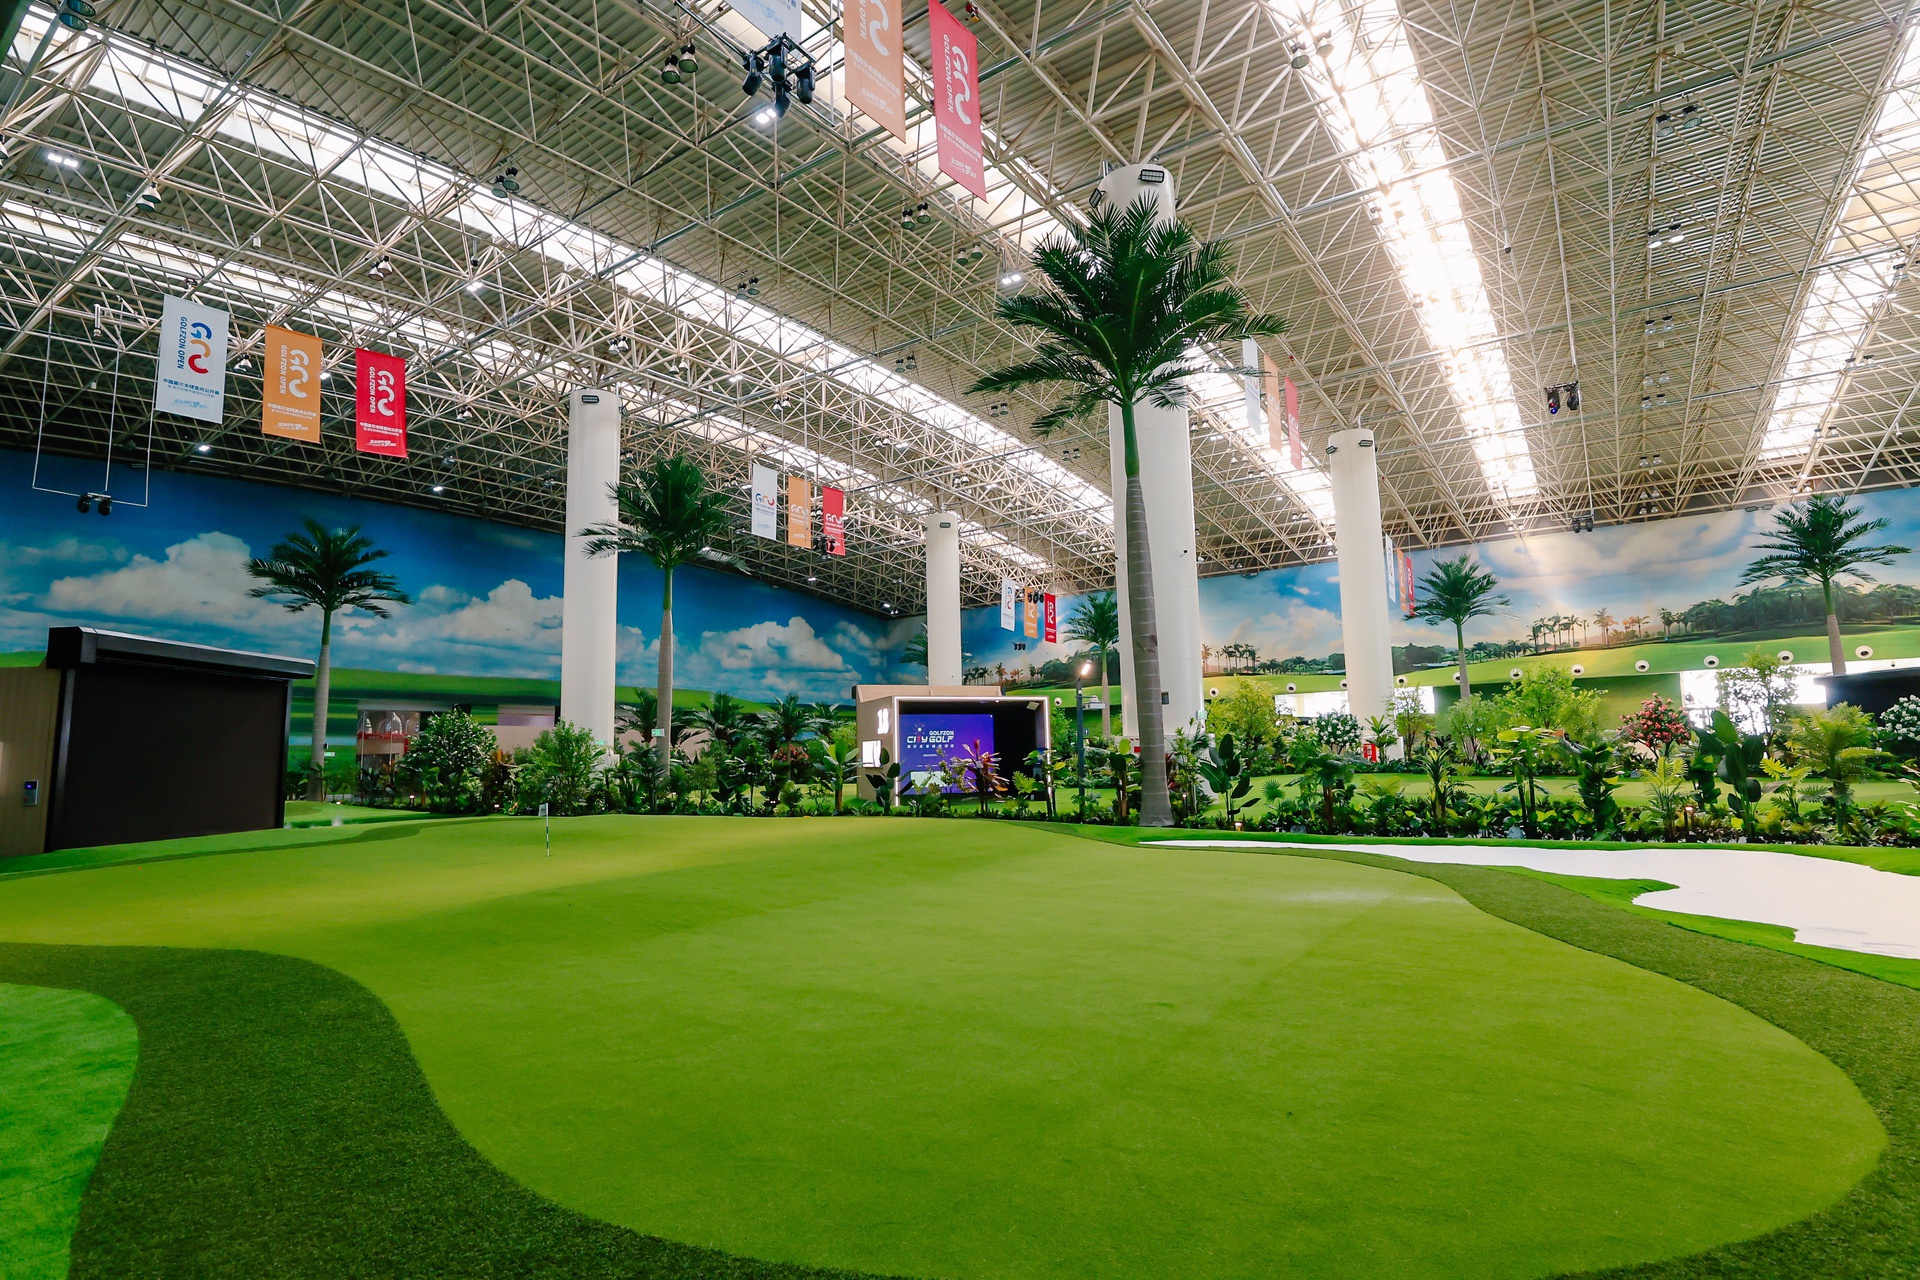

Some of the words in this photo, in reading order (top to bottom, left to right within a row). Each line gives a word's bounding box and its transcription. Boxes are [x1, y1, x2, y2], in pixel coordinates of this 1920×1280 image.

[859, 7, 867, 40] OPEN
[943, 34, 952, 83] GOLFZON
[946, 83, 954, 113] OPEN
[179, 317, 188, 349] GOLFZON
[178, 350, 186, 370] OPEN
[280, 345, 288, 375] GOLFZON
[279, 376, 287, 394] OPEN
